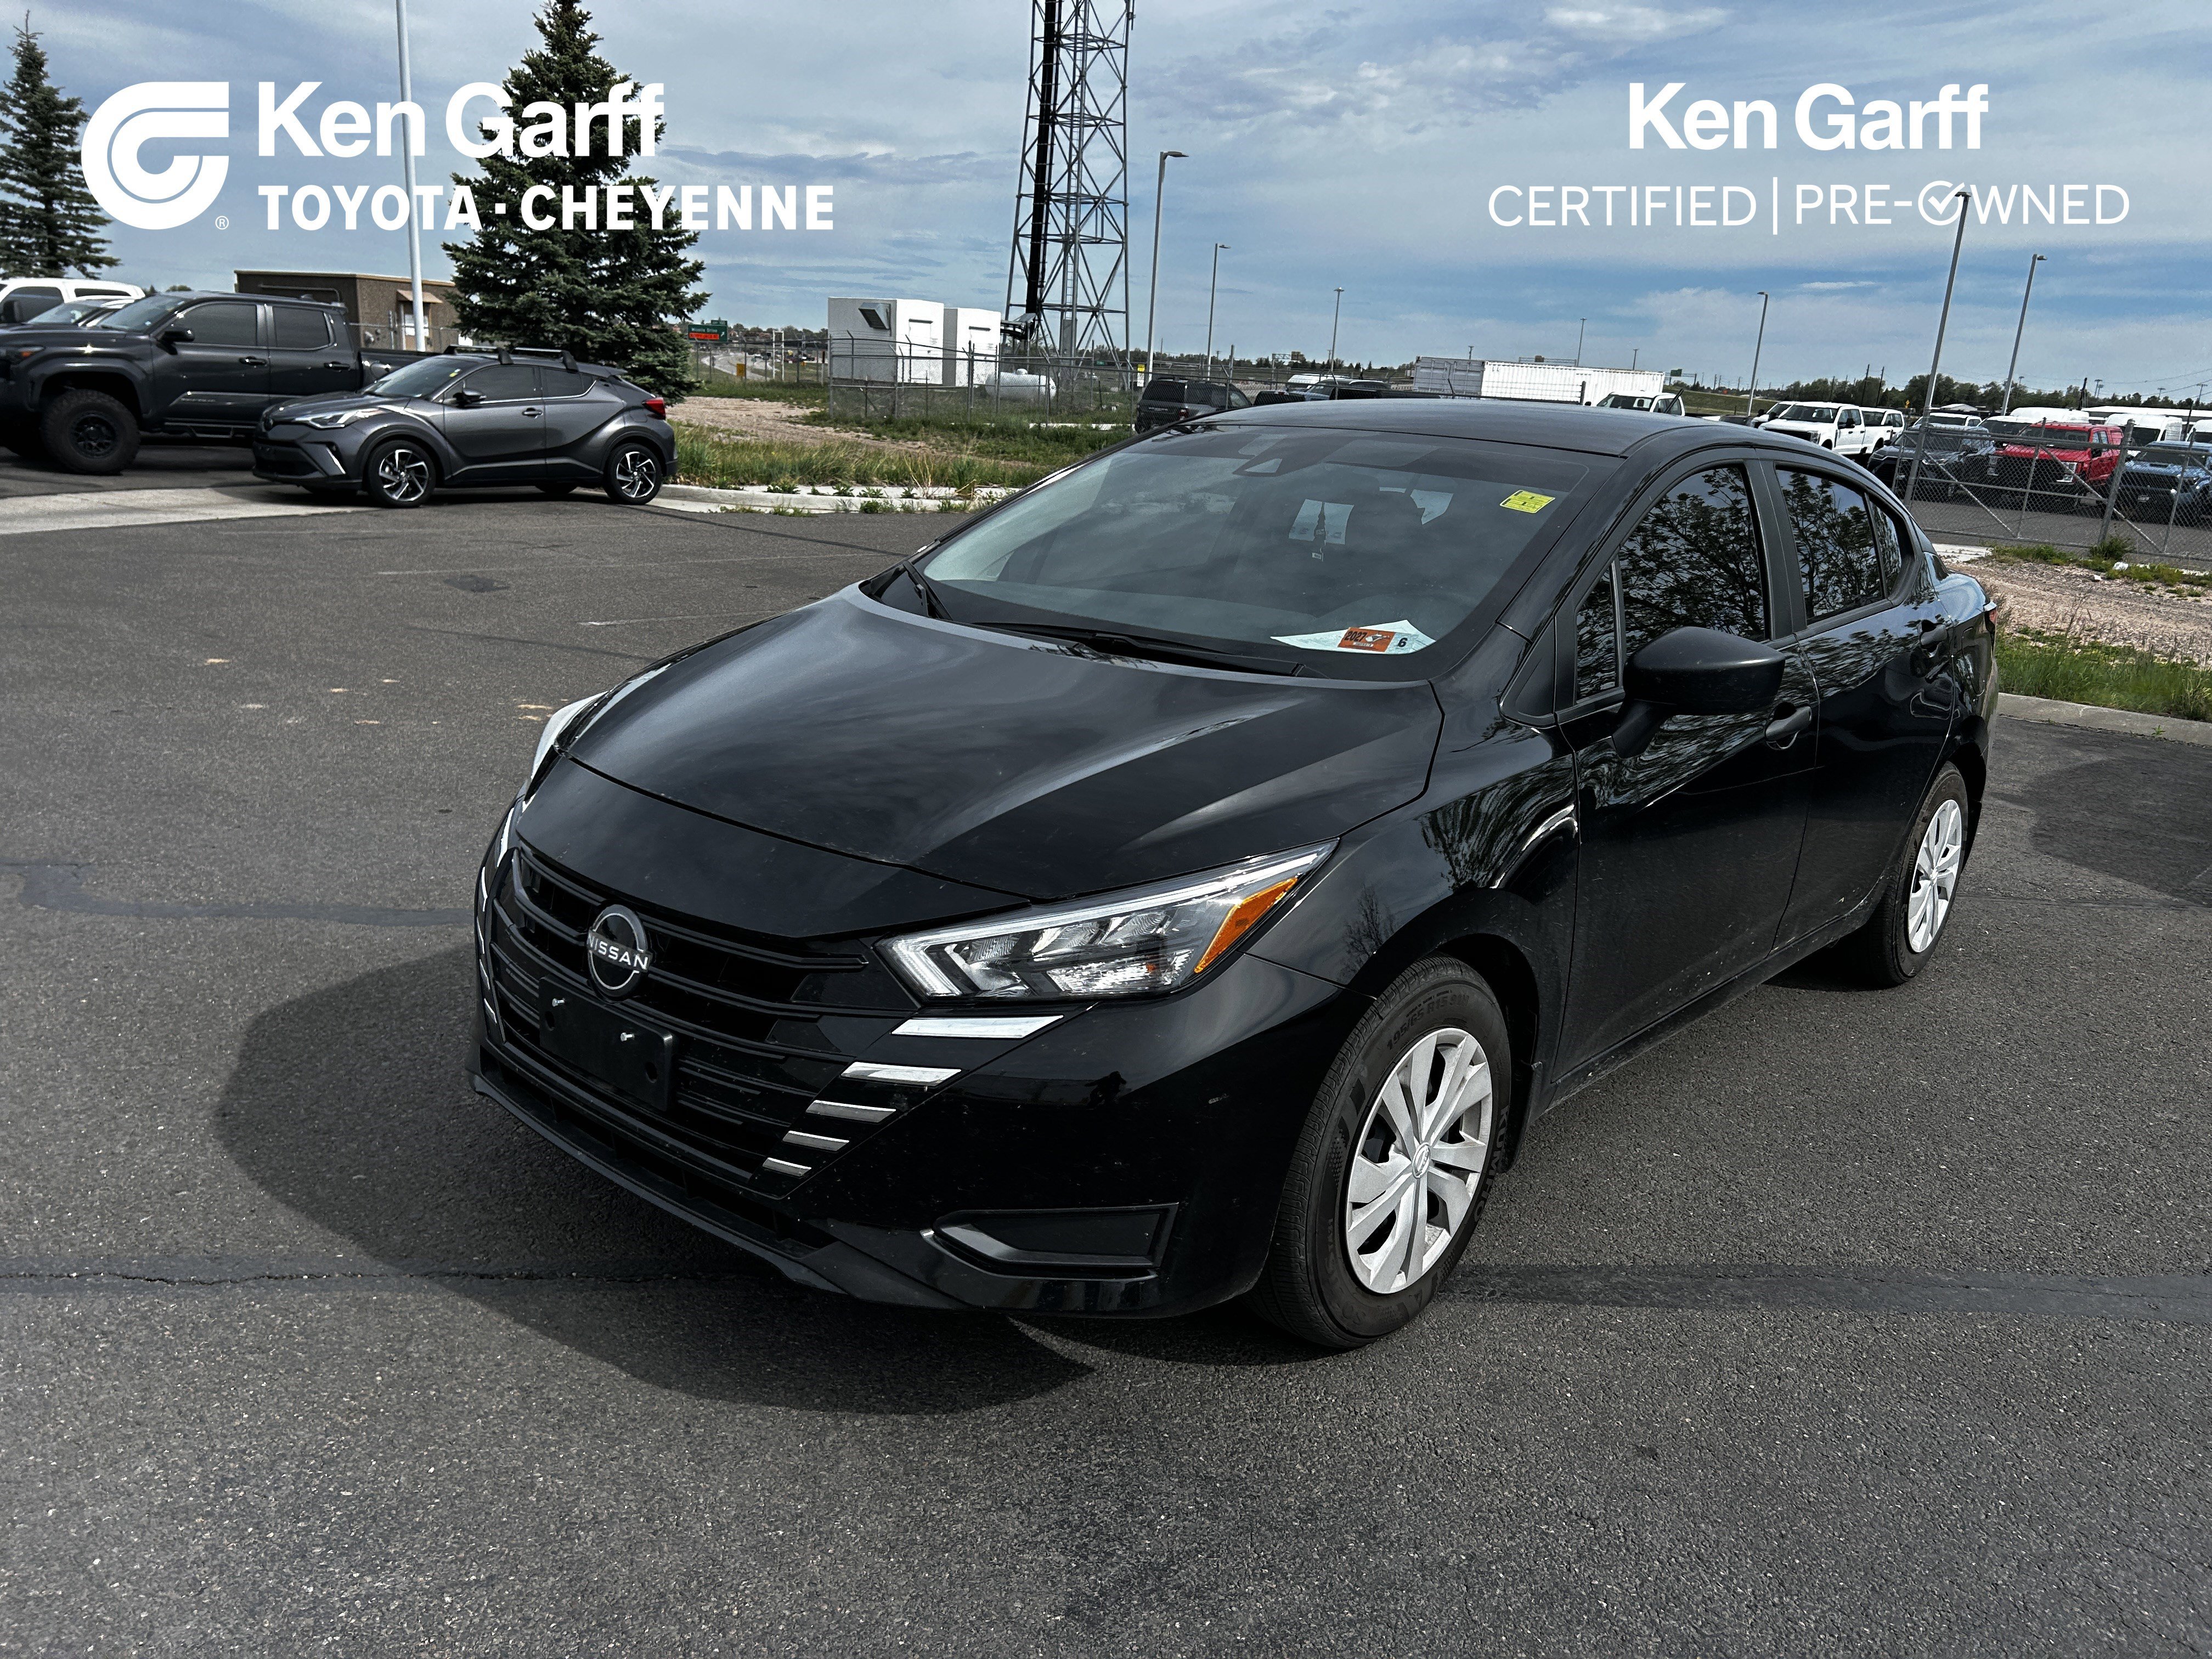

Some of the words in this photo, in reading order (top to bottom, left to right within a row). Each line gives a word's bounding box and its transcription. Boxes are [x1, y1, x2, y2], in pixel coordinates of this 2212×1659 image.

[1344, 631, 1368, 642] 2027
[1398, 637, 1408, 647] 6
[587, 932, 648, 970] NISSAN
[1474, 1105, 1510, 1222] KUMHO
